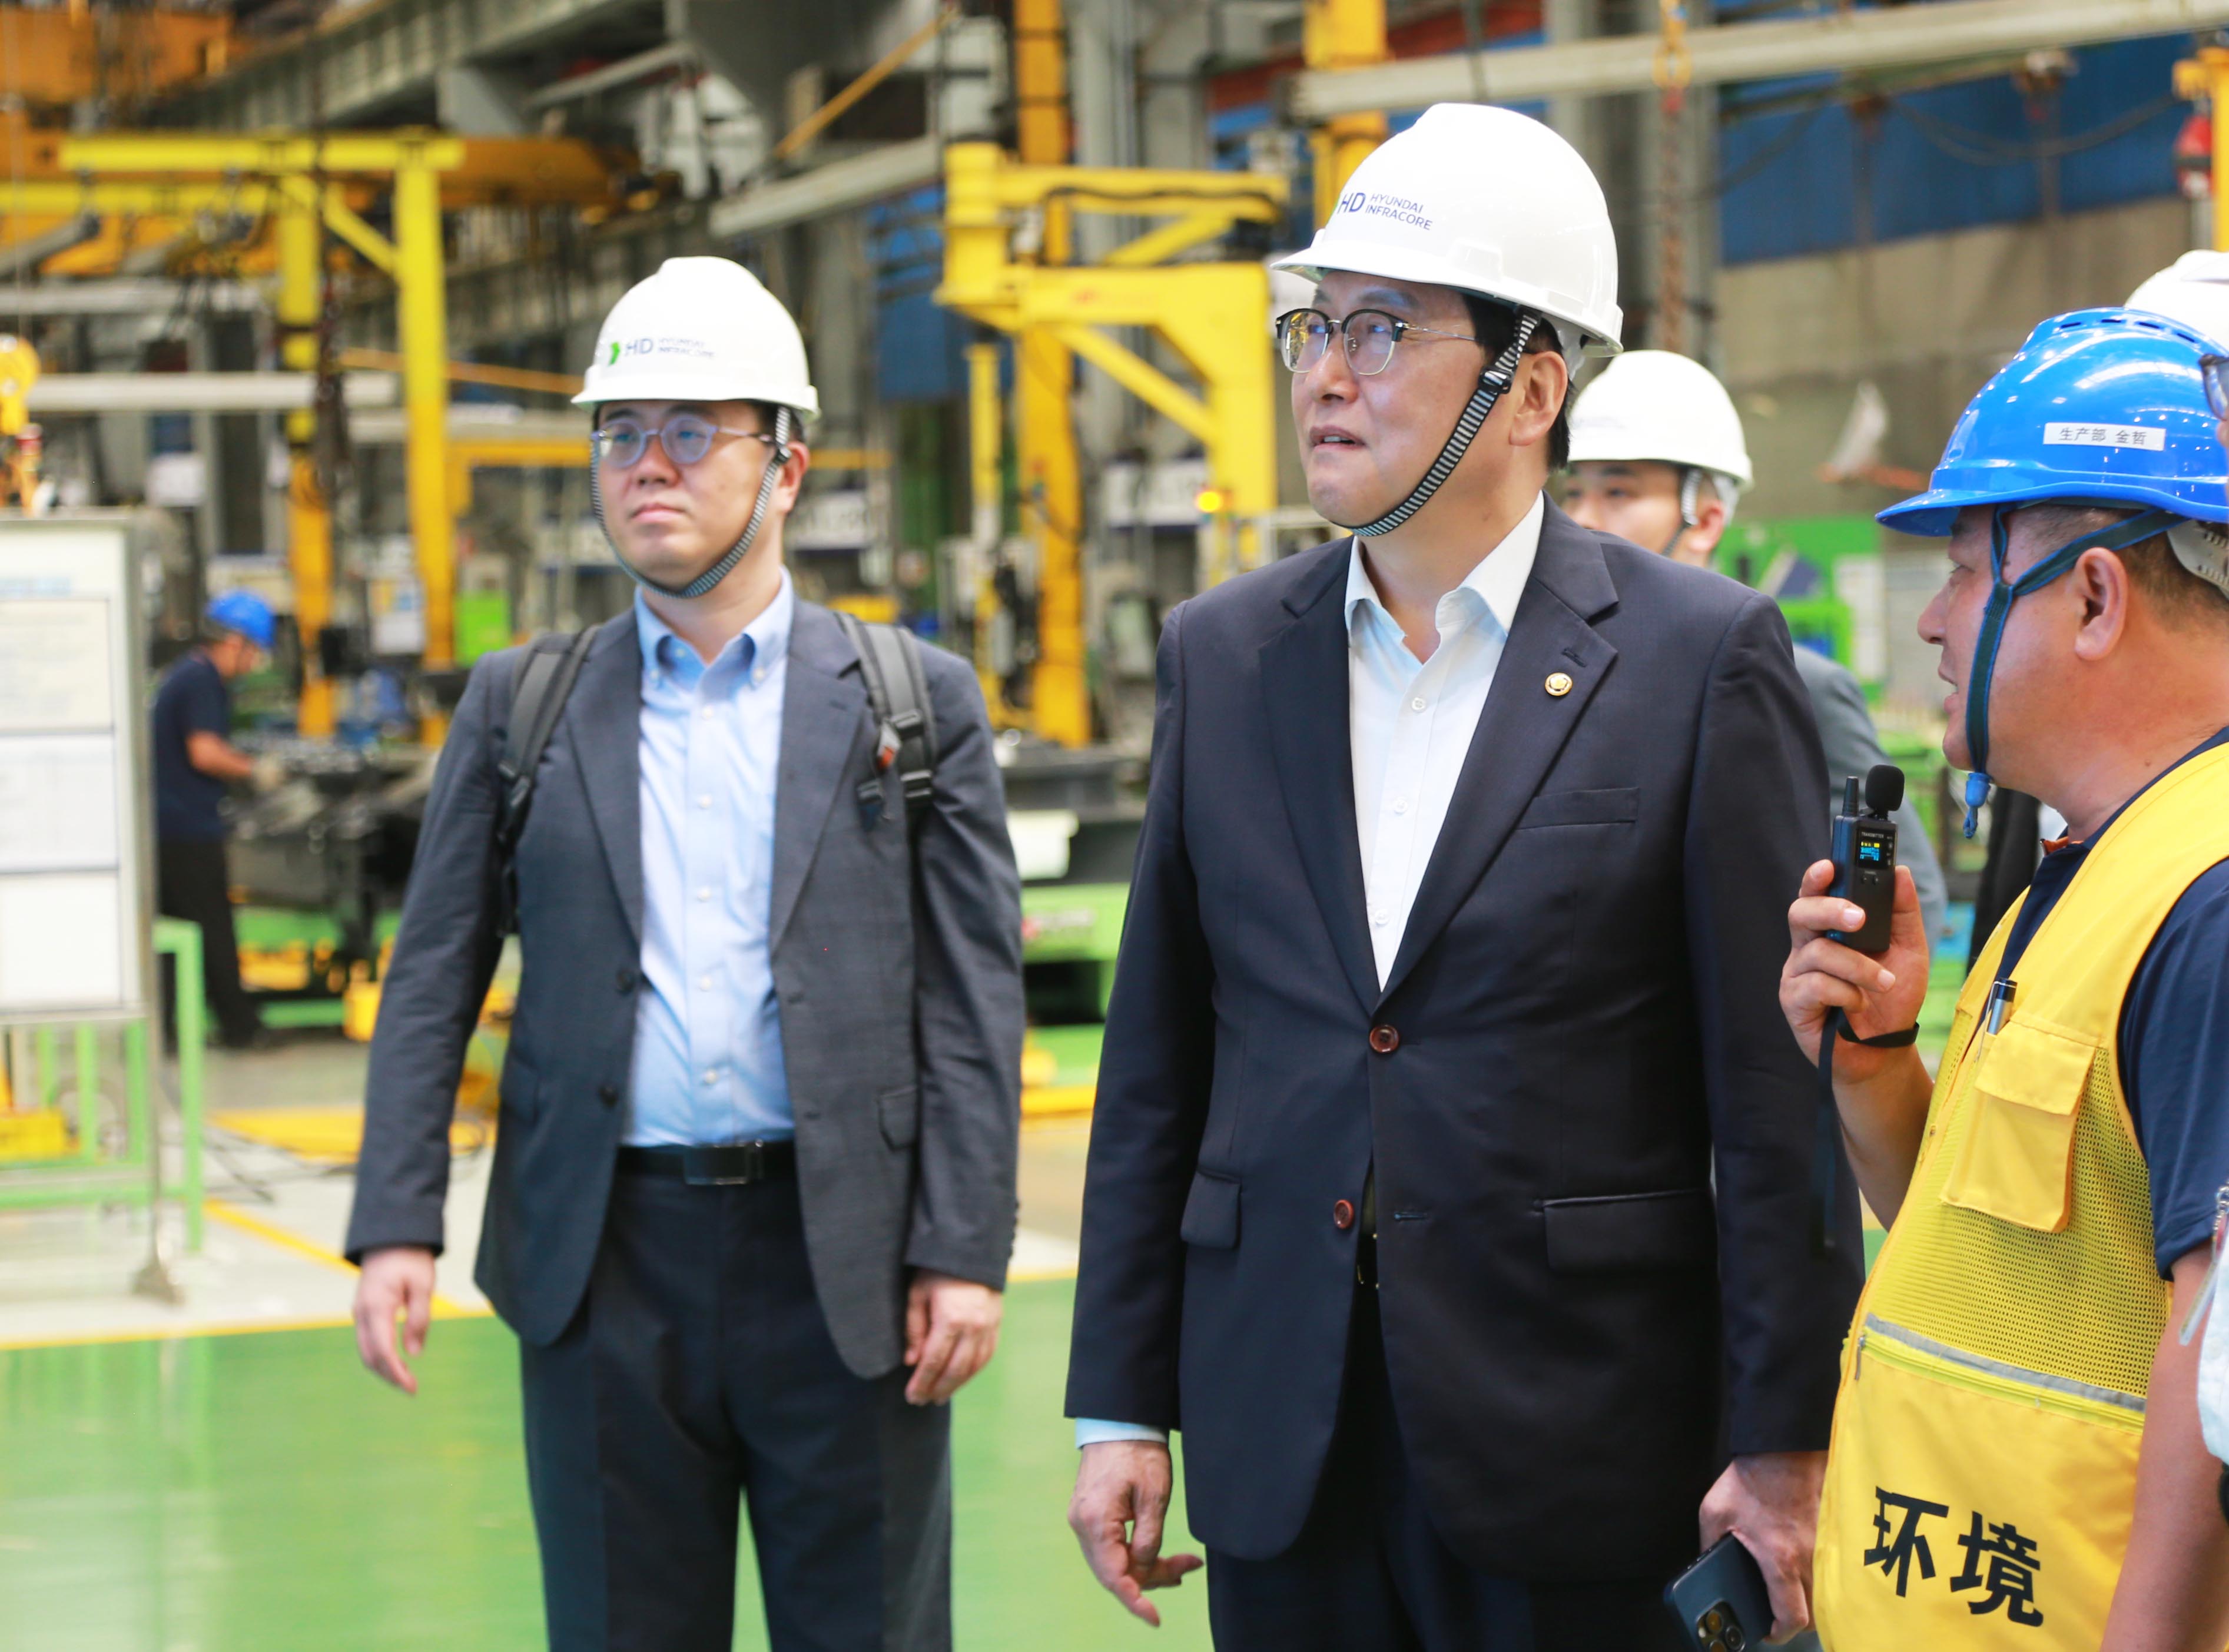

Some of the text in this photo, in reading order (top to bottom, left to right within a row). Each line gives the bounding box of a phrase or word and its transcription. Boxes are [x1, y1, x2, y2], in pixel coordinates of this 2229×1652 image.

[1337, 193, 1366, 214] HD
[1370, 193, 1424, 214] HYUNDAI
[1365, 204, 1432, 231] INFRACORE
[624, 337, 654, 357] HD
[2058, 427, 2107, 442] 生产部
[1863, 1486, 2044, 1628] 环境
